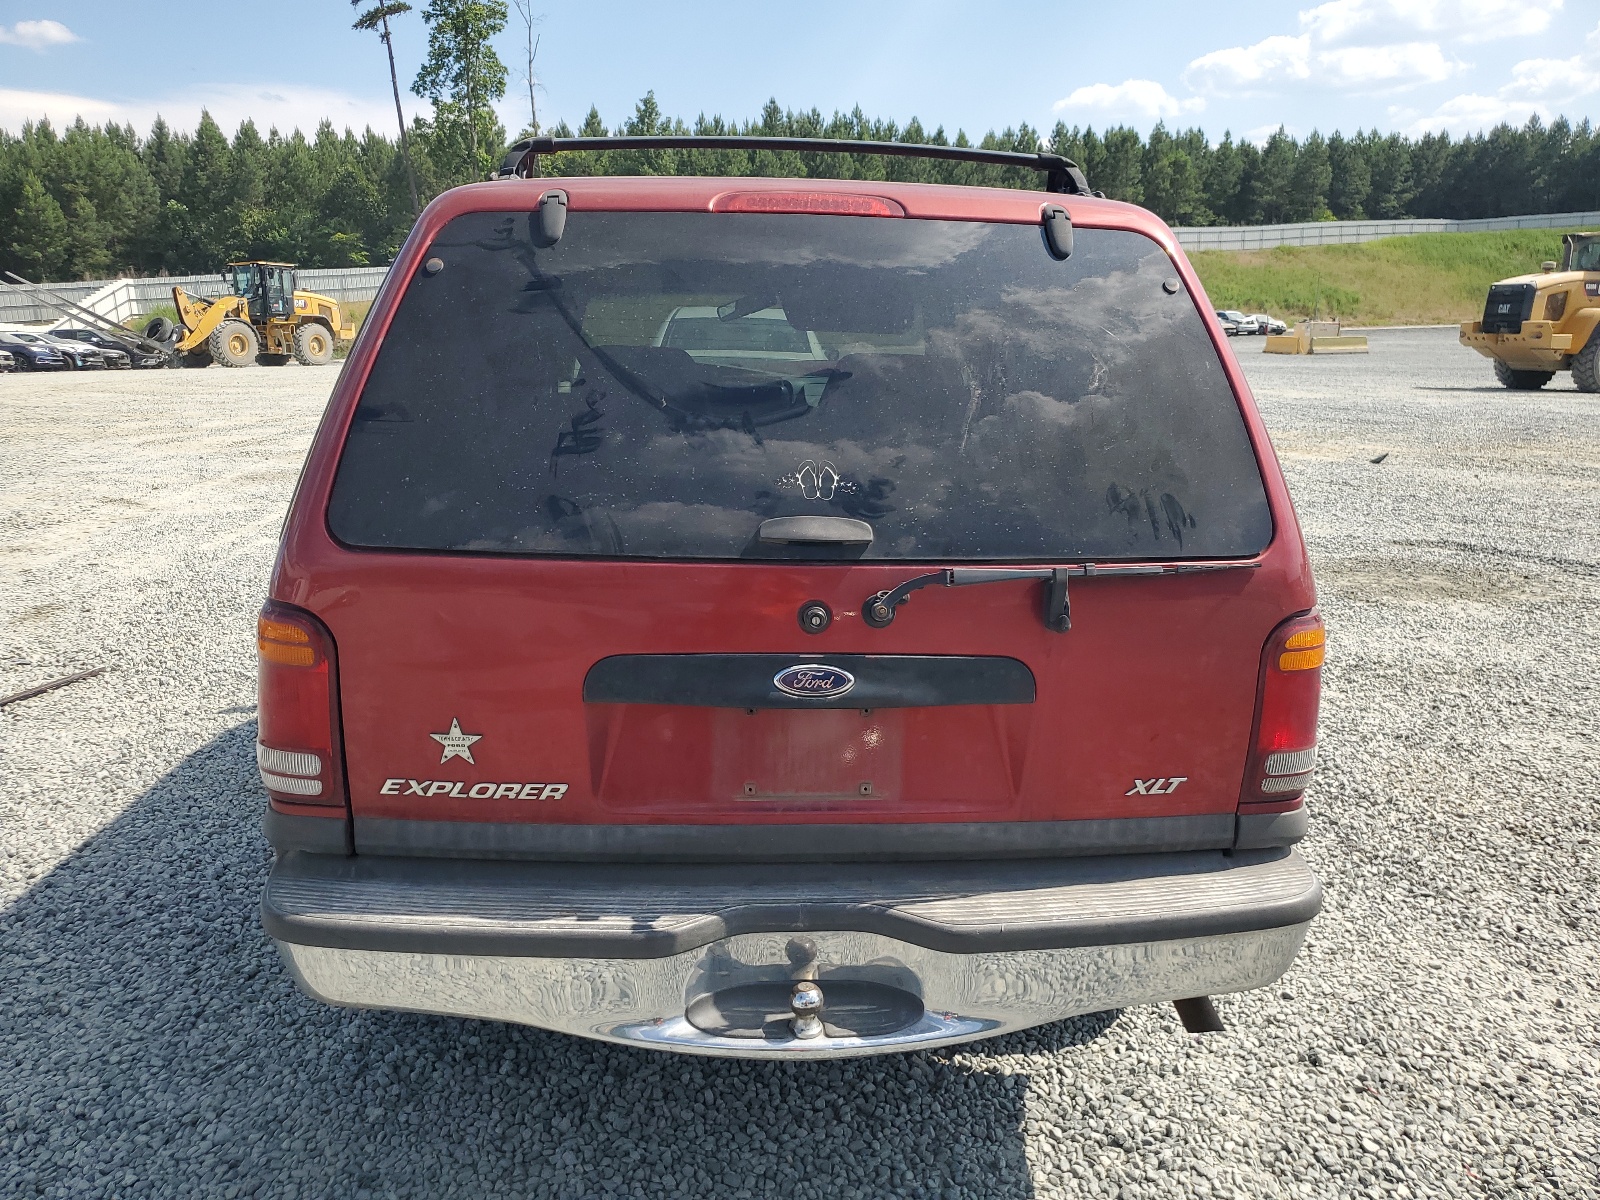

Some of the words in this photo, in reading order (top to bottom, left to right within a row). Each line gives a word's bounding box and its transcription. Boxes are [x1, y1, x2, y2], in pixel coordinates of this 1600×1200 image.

[1498, 304, 1510, 314] CAT
[793, 671, 835, 688] Ford
[379, 778, 569, 801] EXPLORER
[1124, 777, 1188, 796] XLT
